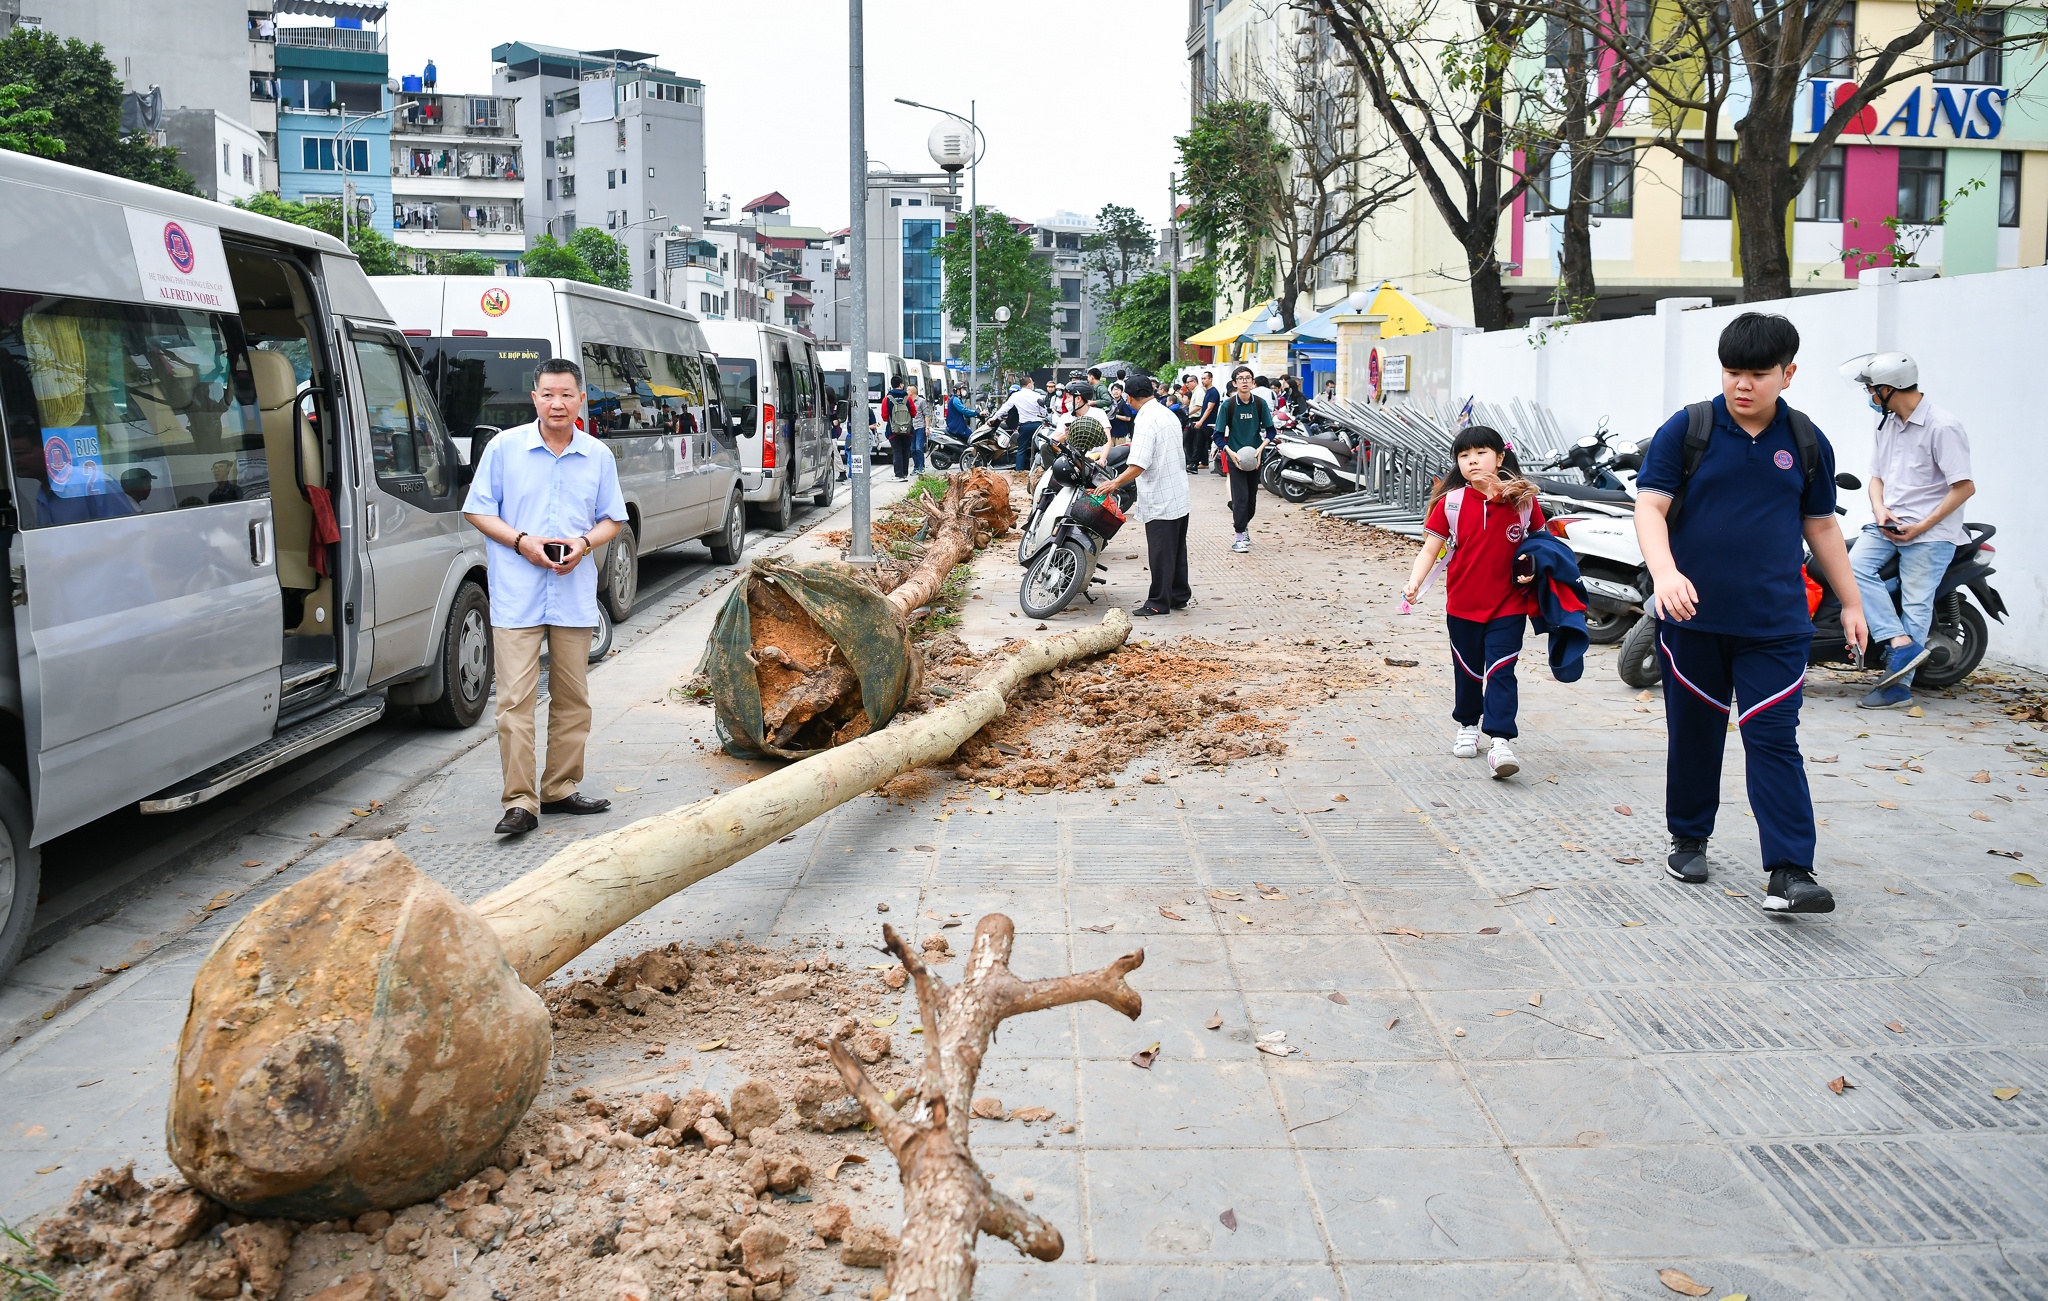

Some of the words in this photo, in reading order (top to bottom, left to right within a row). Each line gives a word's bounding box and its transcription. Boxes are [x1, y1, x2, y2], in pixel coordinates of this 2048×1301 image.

[160, 287, 193, 302] ALFRED
[194, 291, 222, 306] NOBEL
[508, 352, 521, 361] HỢP
[74, 437, 98, 457] BUS
[83, 460, 101, 496] 2
